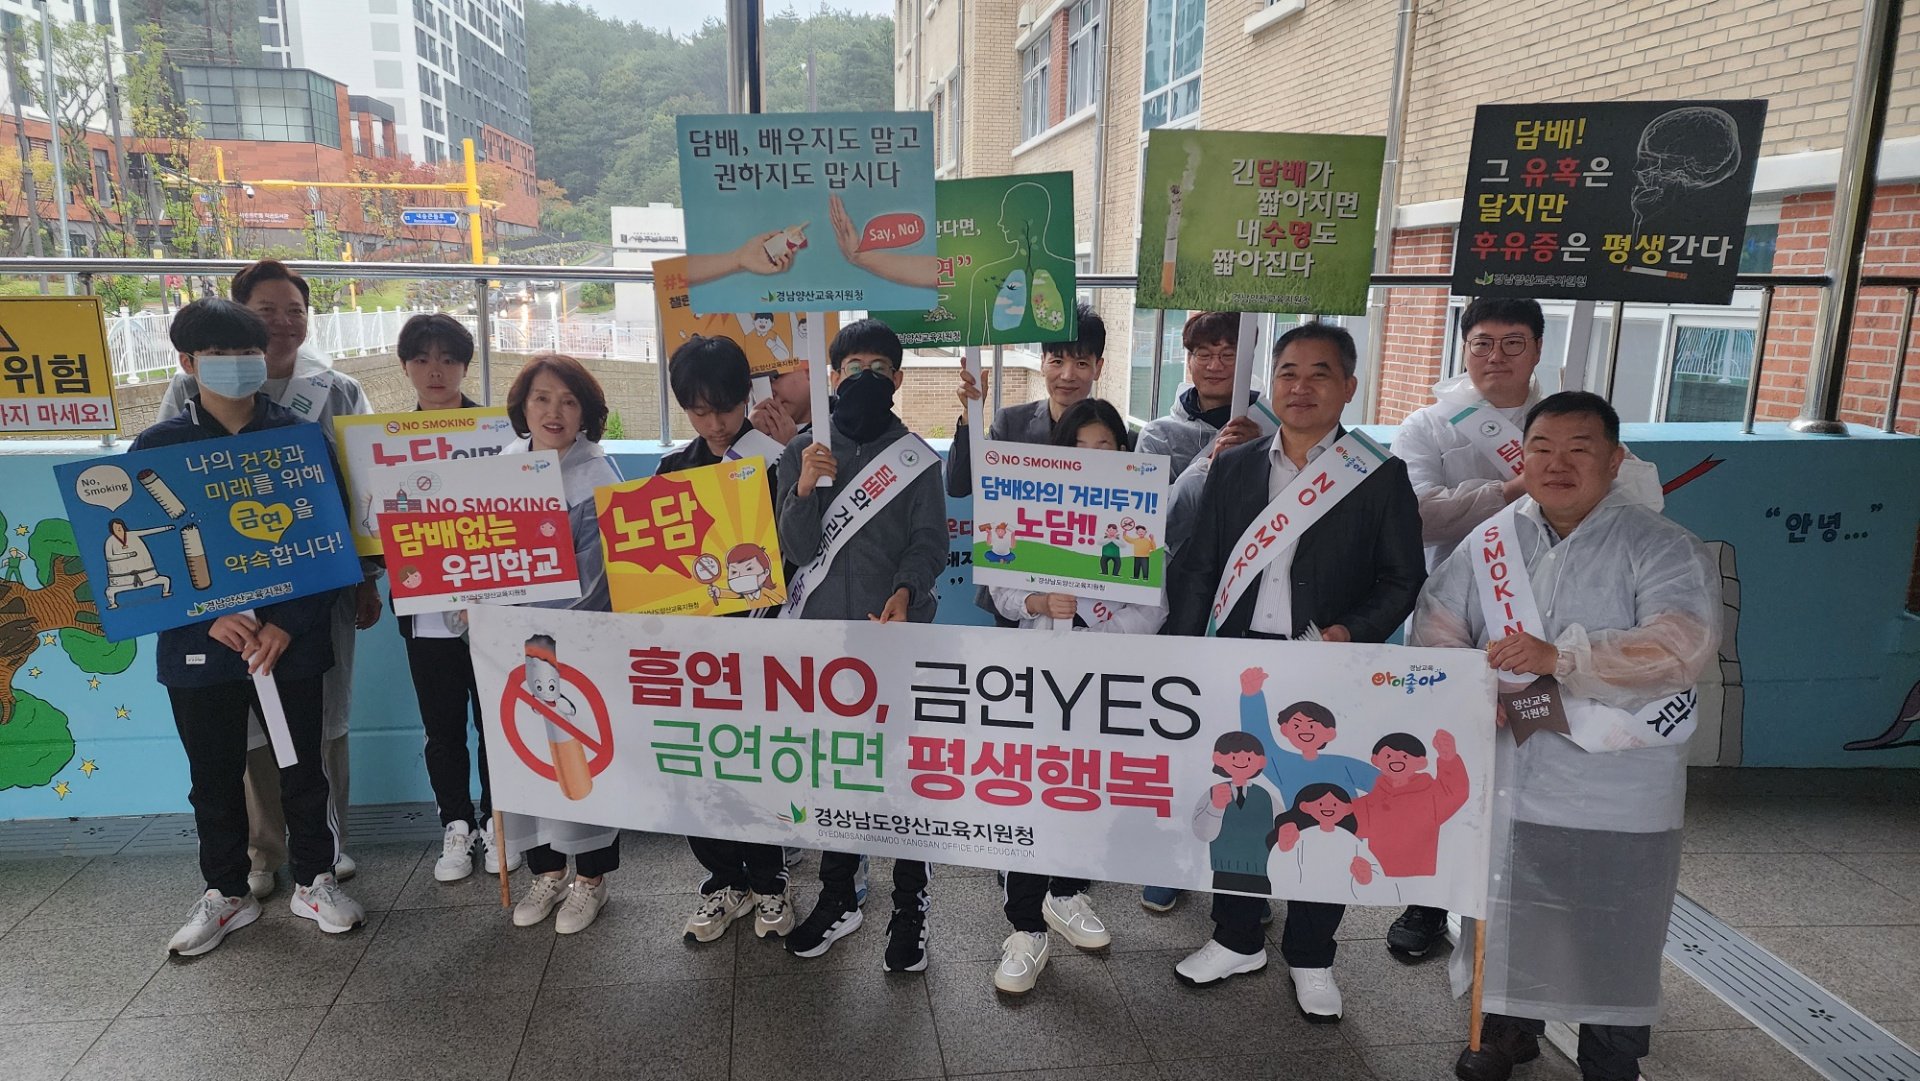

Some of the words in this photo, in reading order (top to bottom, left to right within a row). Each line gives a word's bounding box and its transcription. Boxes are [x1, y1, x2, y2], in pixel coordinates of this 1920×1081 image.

[689, 129, 748, 158] 담배,
[759, 127, 861, 156] 배우지도
[871, 126, 921, 154] 말고
[1514, 117, 1587, 150] 담배!
[714, 163, 815, 190] 권하지도
[825, 162, 901, 189] 맙시다
[1231, 158, 1335, 188] 긴담배가
[1480, 159, 1510, 182] 그
[1520, 157, 1614, 188] 유혹은
[1257, 189, 1360, 219] 짧아지면
[1478, 193, 1568, 223] 달지만
[869, 227, 896, 242] Say,
[898, 220, 920, 236] No!
[1236, 220, 1338, 249] 내수명도
[1212, 249, 1316, 279] 짧아진다
[1470, 232, 1590, 263] 후유증은
[1602, 233, 1734, 266] 평생간다
[776, 290, 864, 302] 경남양산교육지원청
[1494, 273, 1588, 288] 경남양산교육지원청
[4, 354, 91, 394] 위험
[37, 402, 109, 425] 마세요!
[402, 421, 420, 431] NO
[422, 418, 476, 430] SMOKING
[185, 450, 234, 476] 나의
[240, 444, 305, 475] 건강과
[1001, 454, 1020, 466] NO
[1023, 456, 1082, 471] SMOKING
[81, 477, 101, 488] No,
[204, 472, 275, 502] 미래를
[281, 463, 325, 490] 위해
[849, 464, 898, 511] 담배와
[981, 475, 1064, 505] 담배와의
[1068, 485, 1159, 515] 거리두기!
[1298, 471, 1336, 506] NO
[426, 497, 457, 513] NO
[463, 496, 561, 513] SMOKING
[236, 508, 284, 533] 금연
[392, 514, 517, 557] 담배없는
[612, 491, 698, 553] 노담
[1014, 507, 1097, 546] 노담!!
[225, 531, 343, 575] 약속합니다!
[442, 547, 563, 588] 우리학교
[1213, 513, 1290, 618] SMOKING
[205, 582, 293, 613] 경남양산교육지원청
[1038, 576, 1106, 592] 경상남도양산교육지원청
[628, 646, 743, 710] 흡연
[763, 655, 890, 723] NO,
[1512, 693, 1552, 711] 양산교육
[1520, 706, 1551, 721] 지원청
[650, 719, 886, 794] 금연하면
[906, 735, 1175, 819] 평생행복
[815, 807, 1035, 846] 경상남도양산교육지원청
[900, 837, 941, 850] YANGSAN
[942, 842, 972, 853] OFFICE
[973, 845, 985, 854] OF
[987, 847, 1036, 859] EDUCATION
